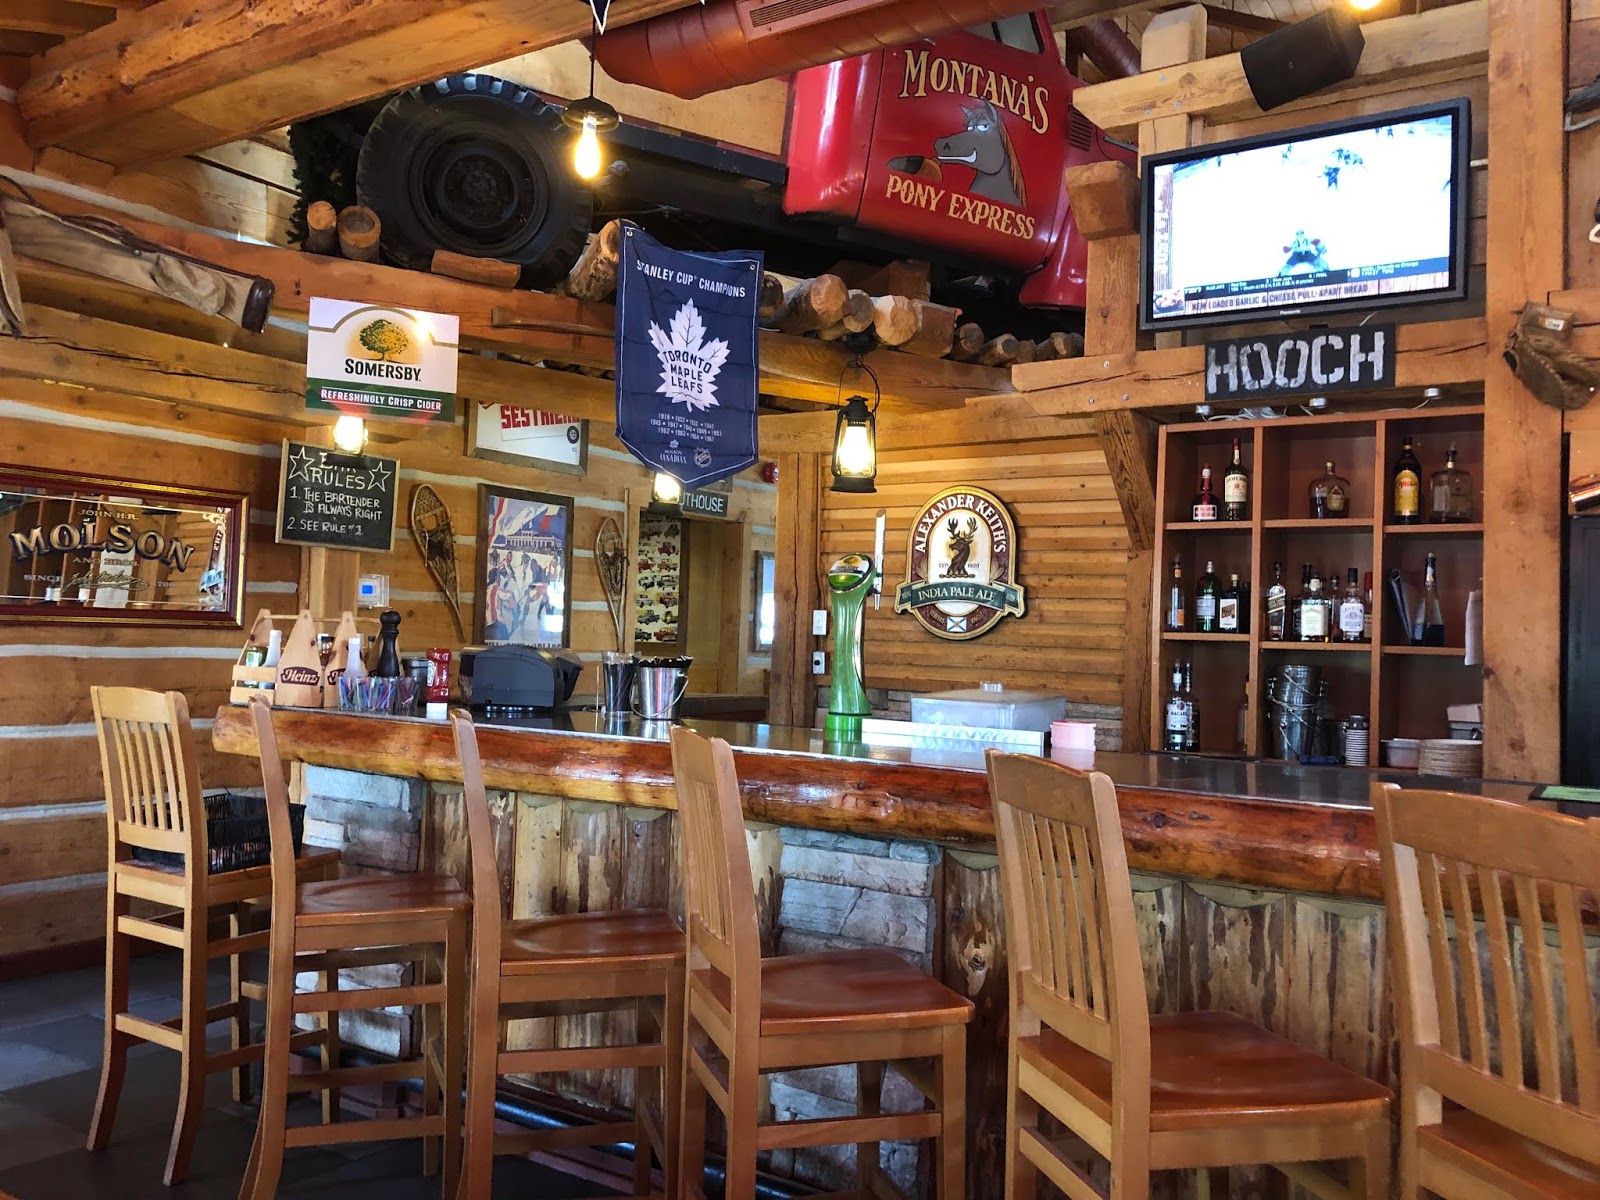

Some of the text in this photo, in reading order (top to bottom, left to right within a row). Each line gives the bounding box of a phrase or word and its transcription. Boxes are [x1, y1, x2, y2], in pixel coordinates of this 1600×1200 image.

[899, 49, 1049, 134] MONTANA'S
[885, 174, 1035, 240] PONY EXPRESS
[636, 260, 674, 282] STANLEY
[698, 278, 746, 298] CHAMPIONS
[1209, 299, 1234, 309] LOADED
[345, 358, 421, 381] SOMERSBY
[663, 350, 712, 374] TORONTO
[1206, 331, 1385, 394] HOOCH
[670, 364, 703, 381] MAPLE
[671, 376, 703, 394] LEAFS
[321, 390, 441, 411] REFRESHINGLY CRISP CIDER
[310, 467, 365, 490] RULES
[304, 488, 320, 501] THE
[324, 491, 380, 508] BARTENDER
[680, 492, 724, 512] UTHOUSE
[78, 509, 112, 518] JOHN
[303, 501, 382, 520] IS ALWAYS RIGHT
[300, 519, 319, 531] SEE
[322, 522, 346, 534] RULE
[915, 494, 974, 553] ALEXANDER
[976, 499, 1006, 553] KEITH'S
[9, 522, 195, 572] MOLSON
[104, 558, 140, 567] BROS.
[918, 586, 948, 600] INDIA
[950, 586, 974, 597] PALE
[975, 589, 996, 601] ALE
[282, 669, 318, 683] Heinz
